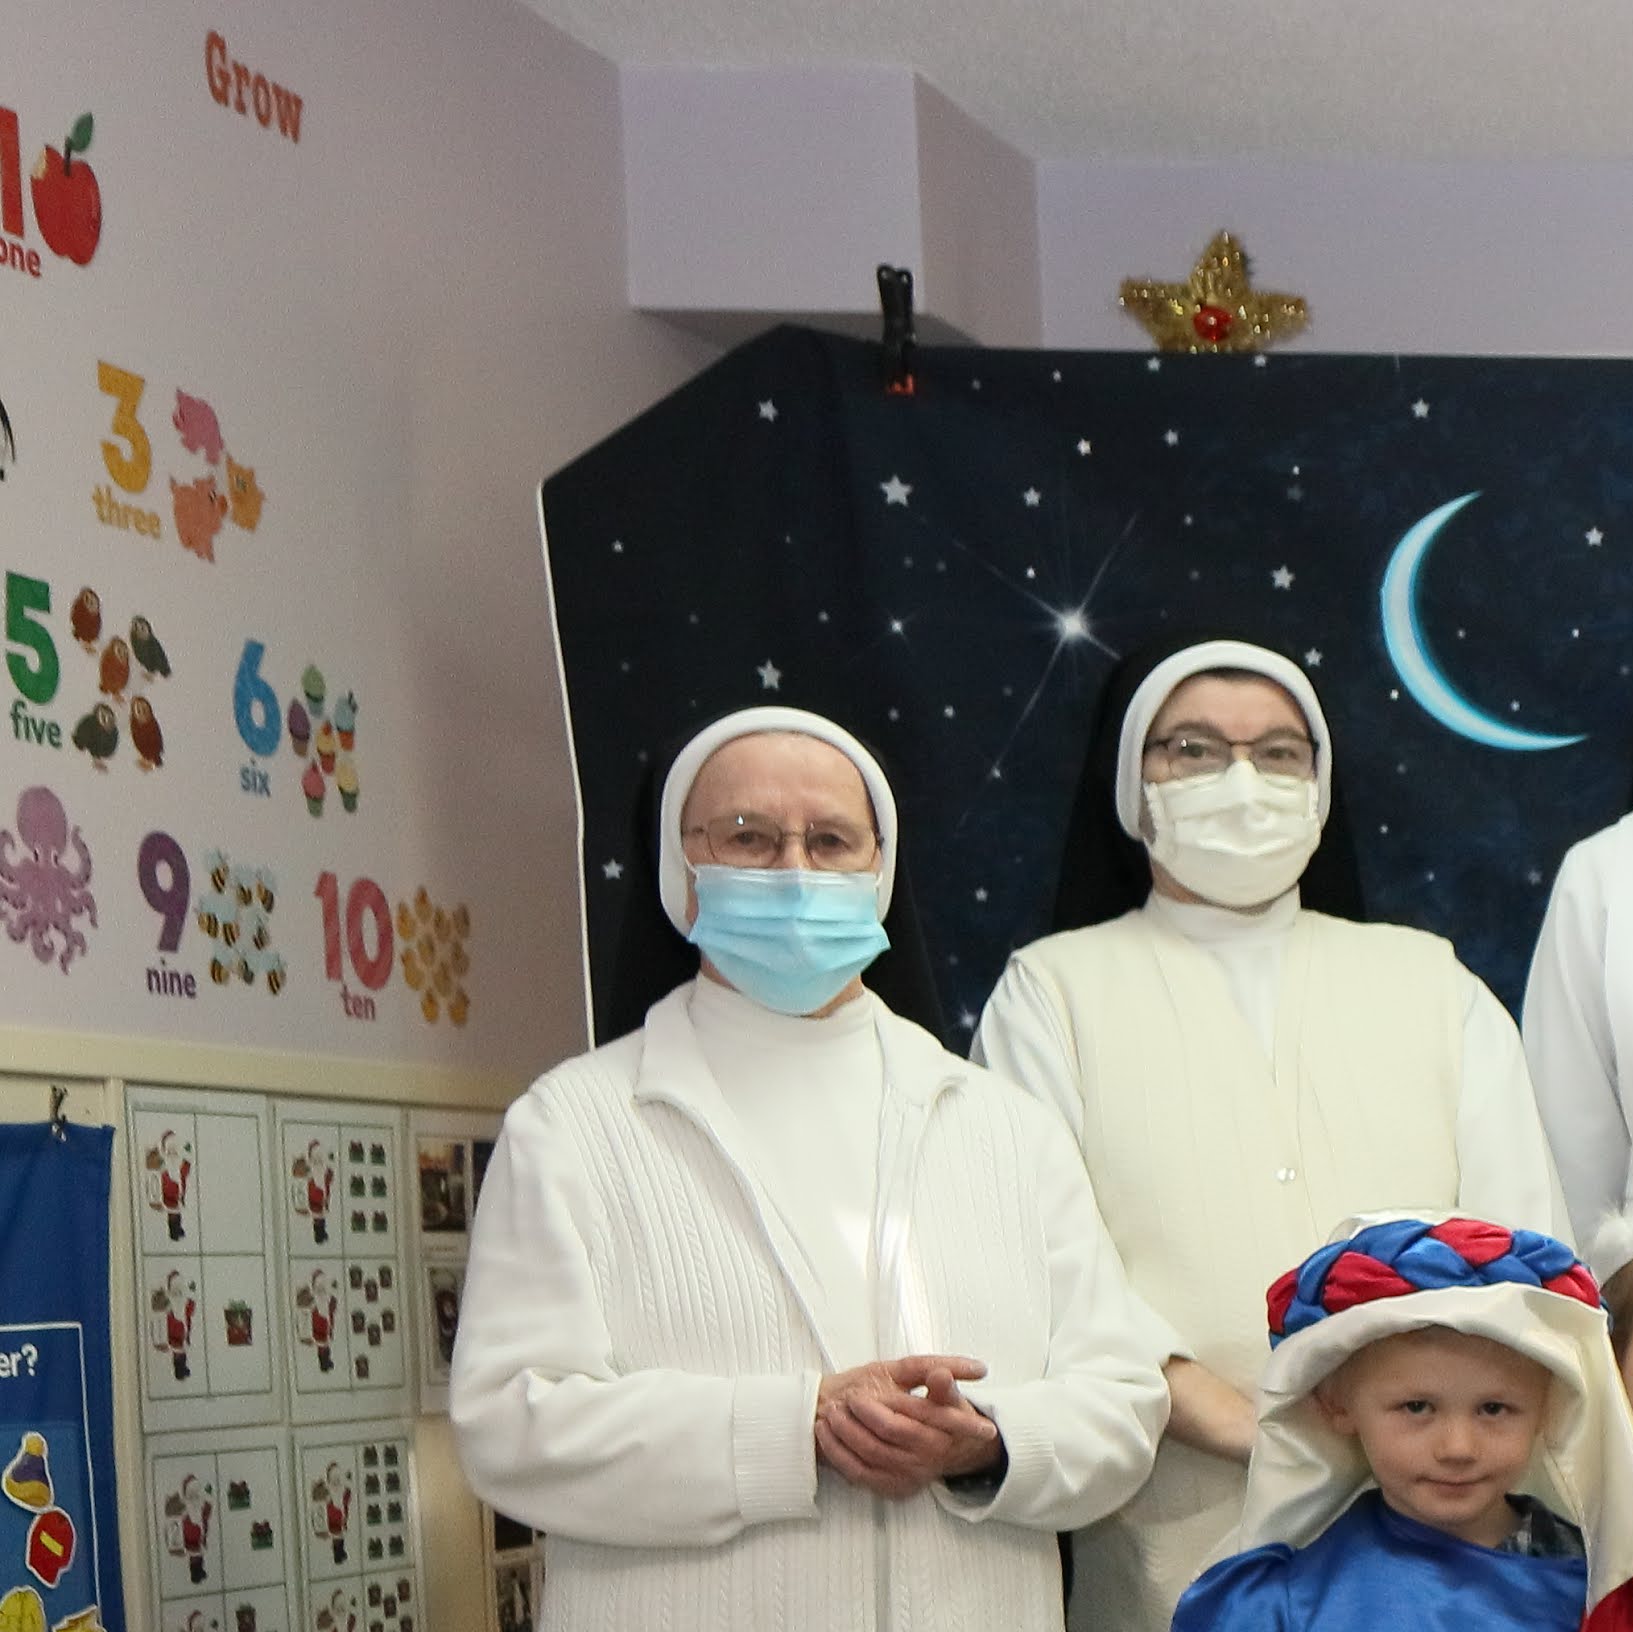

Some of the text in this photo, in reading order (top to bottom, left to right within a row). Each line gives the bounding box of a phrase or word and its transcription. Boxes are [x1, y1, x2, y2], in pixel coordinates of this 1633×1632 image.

[206, 30, 303, 144] Grow
[97, 360, 152, 494] 3
[92, 484, 161, 540] three
[5, 570, 60, 704] 5
[10, 699, 62, 749] five
[233, 638, 282, 756] 6
[240, 758, 271, 797] six
[137, 831, 191, 953] 9
[313, 871, 394, 990] 10
[146, 957, 197, 998] nine
[340, 983, 376, 1021] ten
